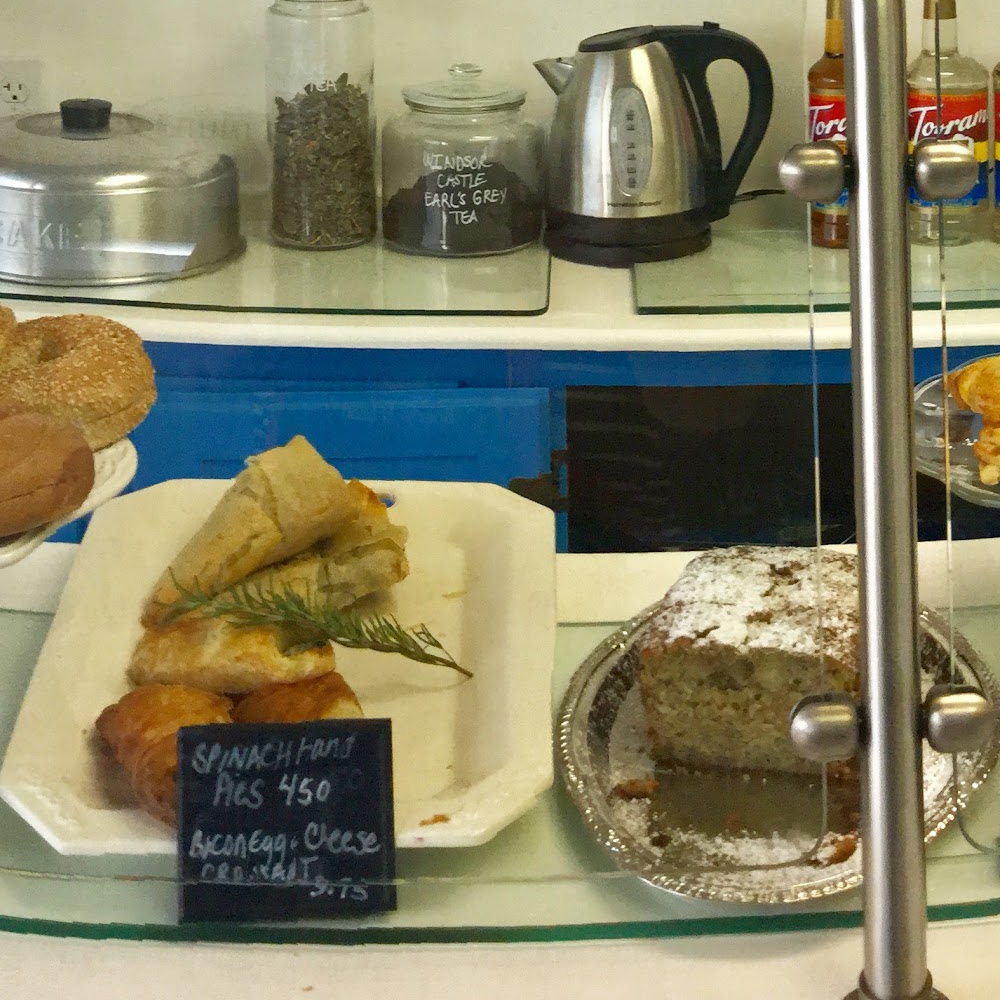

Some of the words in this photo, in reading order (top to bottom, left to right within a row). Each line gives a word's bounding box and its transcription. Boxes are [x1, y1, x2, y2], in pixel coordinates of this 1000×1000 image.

[437, 172, 487, 188] CASTLE
[424, 191, 466, 208] EARL'S
[473, 187, 507, 205] GREY
[449, 210, 478, 225] TEA
